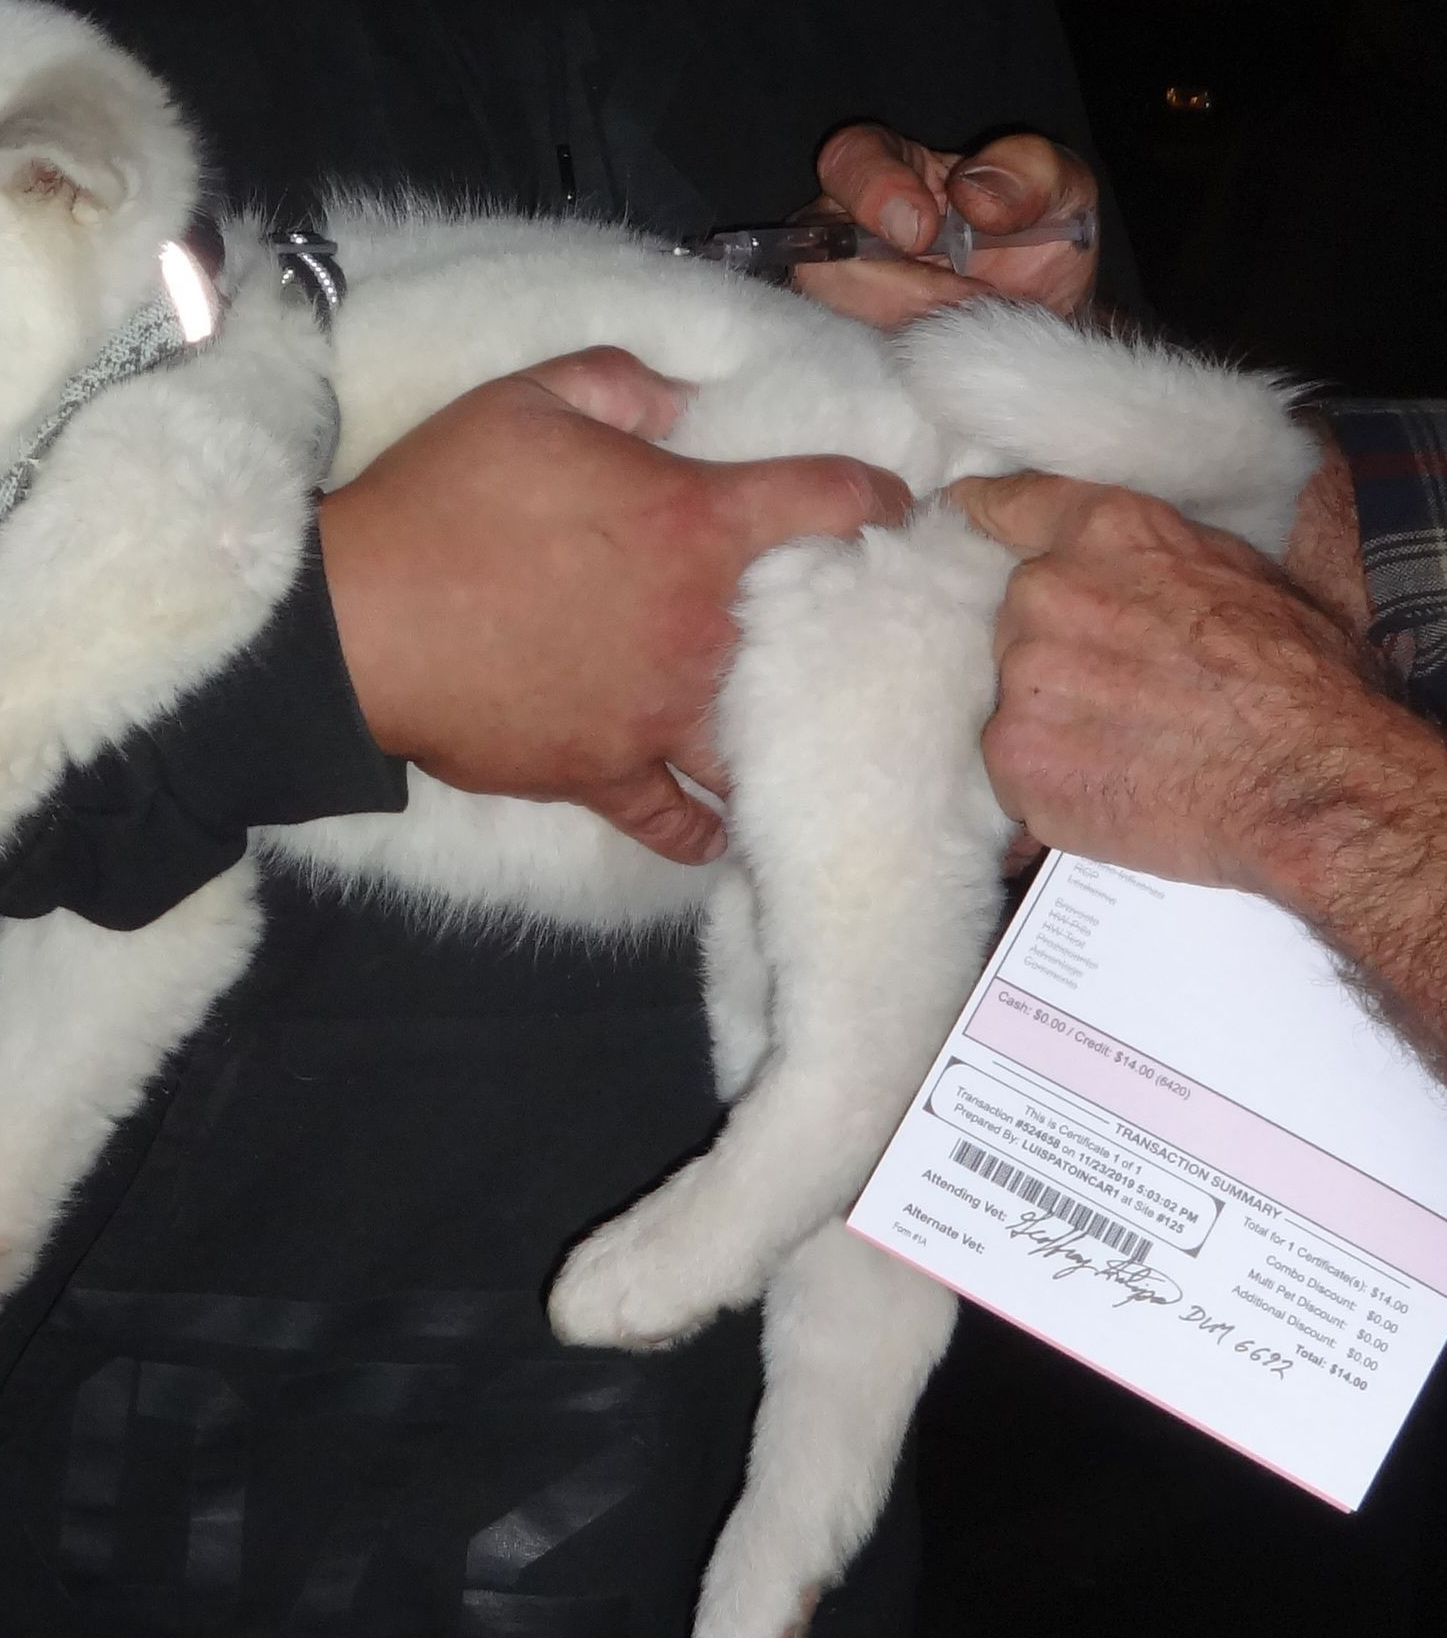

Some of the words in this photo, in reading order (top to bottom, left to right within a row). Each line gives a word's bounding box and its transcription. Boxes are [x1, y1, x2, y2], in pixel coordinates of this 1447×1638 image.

[998, 991, 1032, 1015] Cash:
[1033, 1009, 1066, 1032] $0.00
[1075, 1031, 1112, 1057] Credit:
[1114, 1051, 1155, 1079] $14.00
[1155, 1075, 1190, 1100] (6420)
[954, 1103, 1002, 1134] Prepared
[1002, 1129, 1019, 1145] By:
[1134, 1201, 1154, 1218] Site
[1156, 1213, 1184, 1233] #125
[957, 1086, 1013, 1124] Transaction
[1062, 1146, 1076, 1158] on
[1079, 1153, 1135, 1189] 11/23/2019
[1136, 1184, 1178, 1212] 5:03:02
[1179, 1207, 1199, 1223] PM
[1025, 1105, 1045, 1123] This
[1059, 1125, 1110, 1158] Certificate
[1116, 1123, 1210, 1181] TRANSACTION
[1211, 1176, 1282, 1219] SUMMARY
[903, 1203, 959, 1239] Alternate
[962, 1233, 984, 1254] Vet:
[922, 1170, 981, 1209] Attending
[985, 1201, 1007, 1222] Vet:
[1244, 1216, 1269, 1237] Total
[1270, 1232, 1286, 1245] for
[1297, 1247, 1367, 1292] Certificate(s):
[1370, 1287, 1408, 1314] $14.00
[1266, 1255, 1305, 1282] Combo
[1307, 1277, 1357, 1311] Discount:
[1367, 1310, 1398, 1333] $0.00
[1232, 1285, 1286, 1320] Additional
[1287, 1314, 1337, 1349] Discount:
[1347, 1347, 1378, 1371] $0.00
[1248, 1269, 1275, 1289] Multi
[1276, 1285, 1296, 1301] Pet
[1296, 1296, 1347, 1330] Discount:
[1357, 1329, 1388, 1352] $0.00
[1296, 1344, 1326, 1368] Total:
[1330, 1364, 1367, 1390] $14.00
